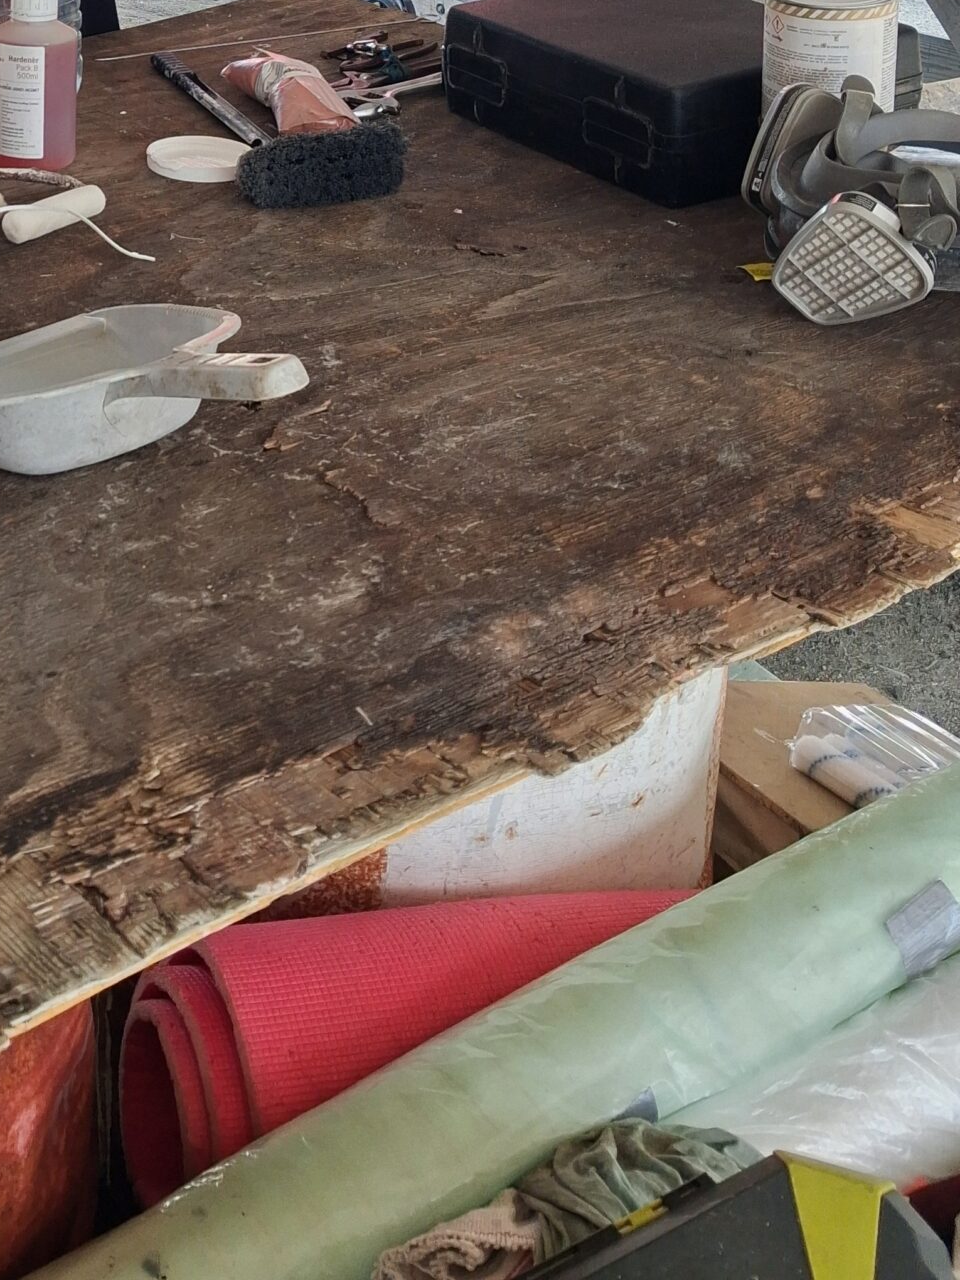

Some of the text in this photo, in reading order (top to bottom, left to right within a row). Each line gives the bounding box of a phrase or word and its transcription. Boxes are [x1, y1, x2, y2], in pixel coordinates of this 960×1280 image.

[8, 55, 39, 64] Hardener
[16, 64, 39, 72] Pack B
[16, 72, 39, 80] 500ml
